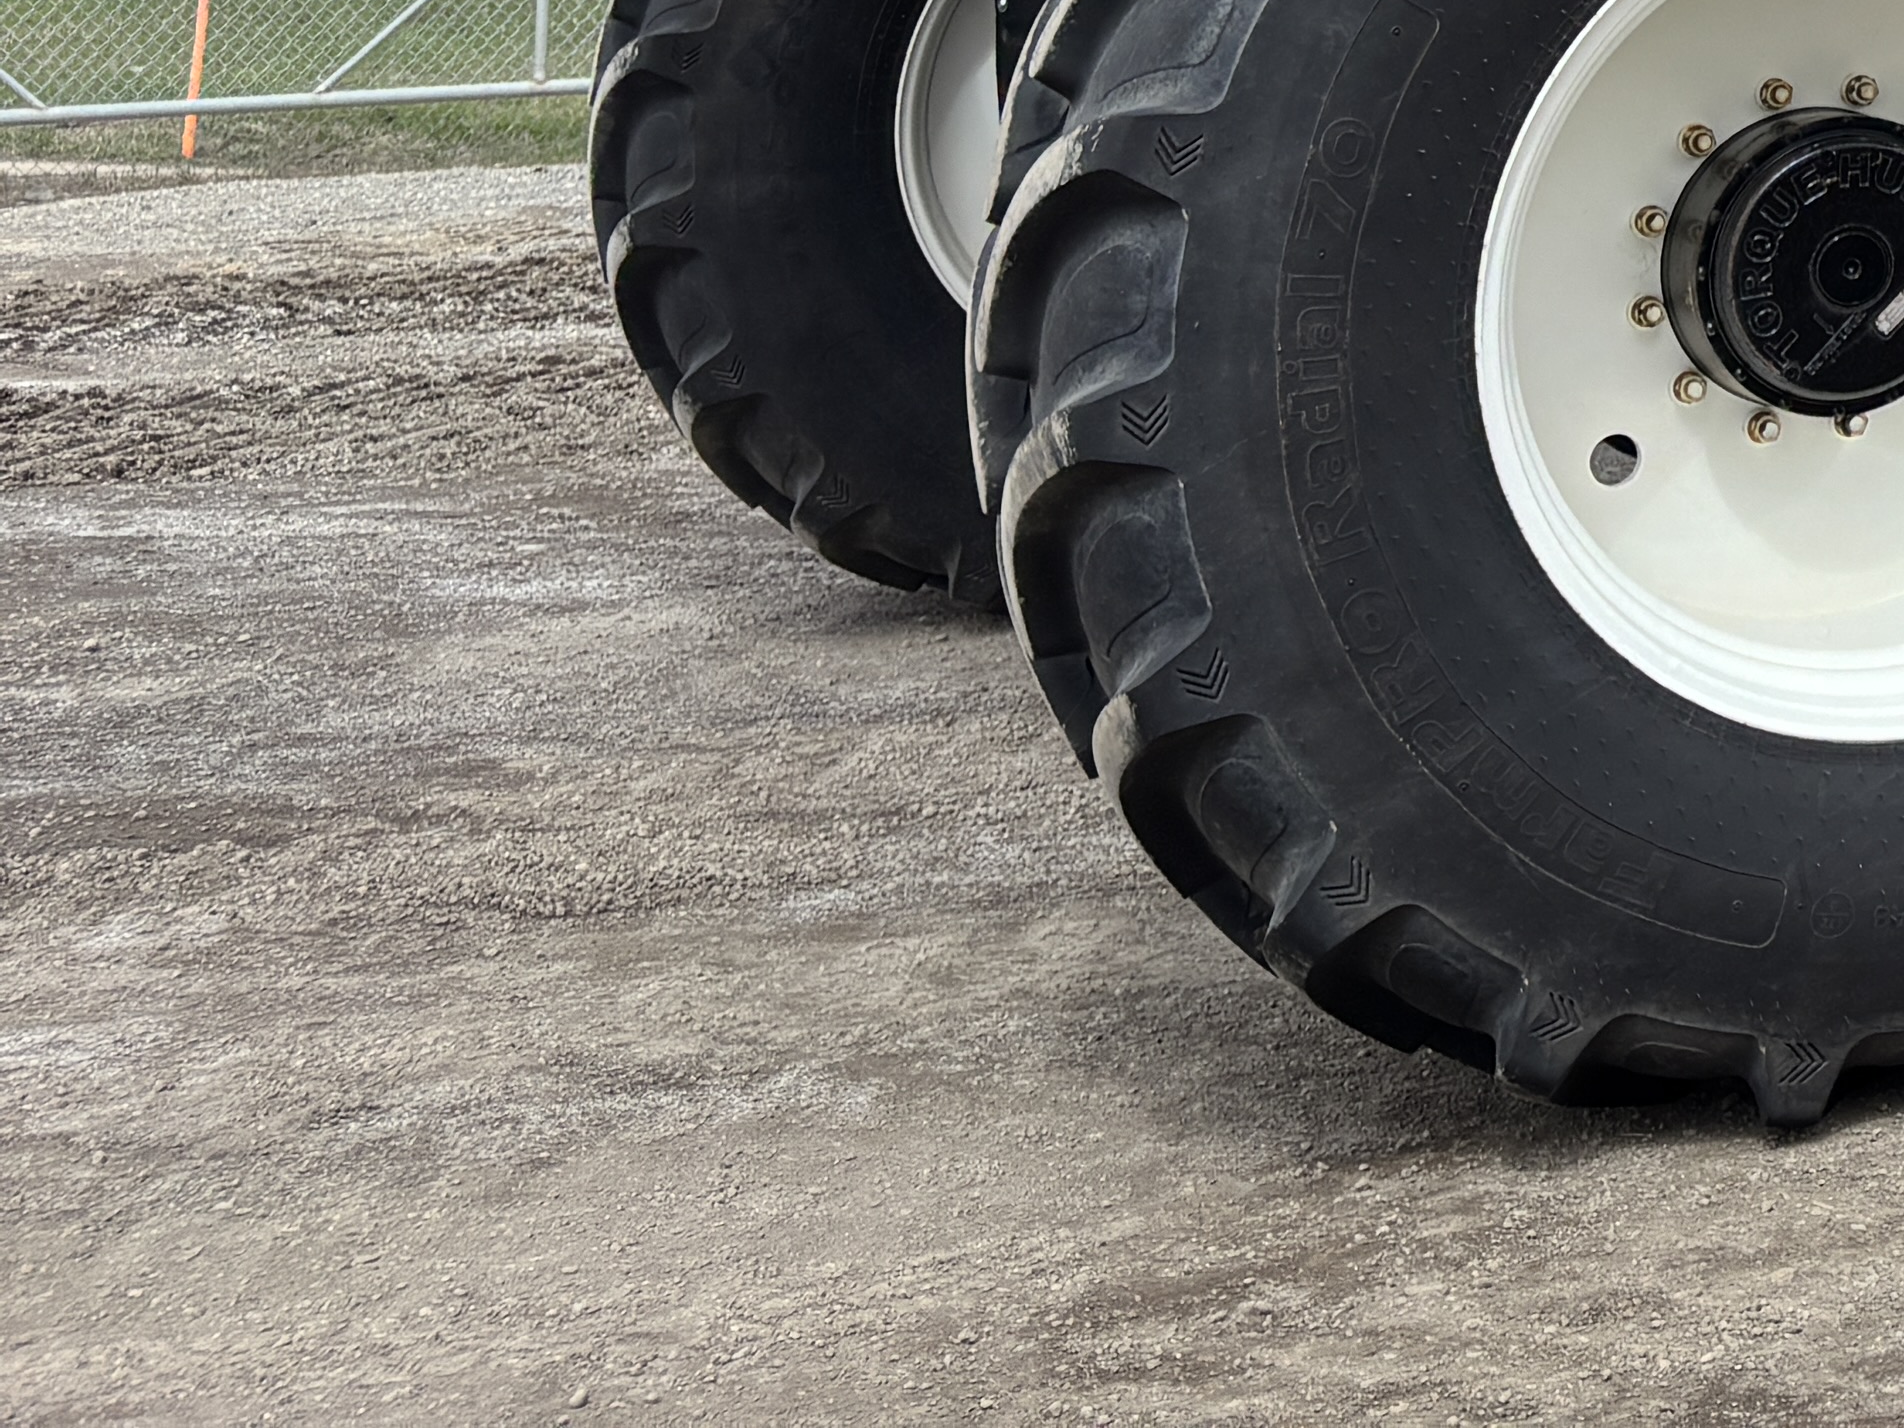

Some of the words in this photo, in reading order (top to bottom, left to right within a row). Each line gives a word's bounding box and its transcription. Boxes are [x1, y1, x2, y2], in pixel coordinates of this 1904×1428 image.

[1294, 115, 1376, 242] 70
[1284, 273, 1374, 566] Radial
[1340, 586, 1678, 910] FarmPRO
